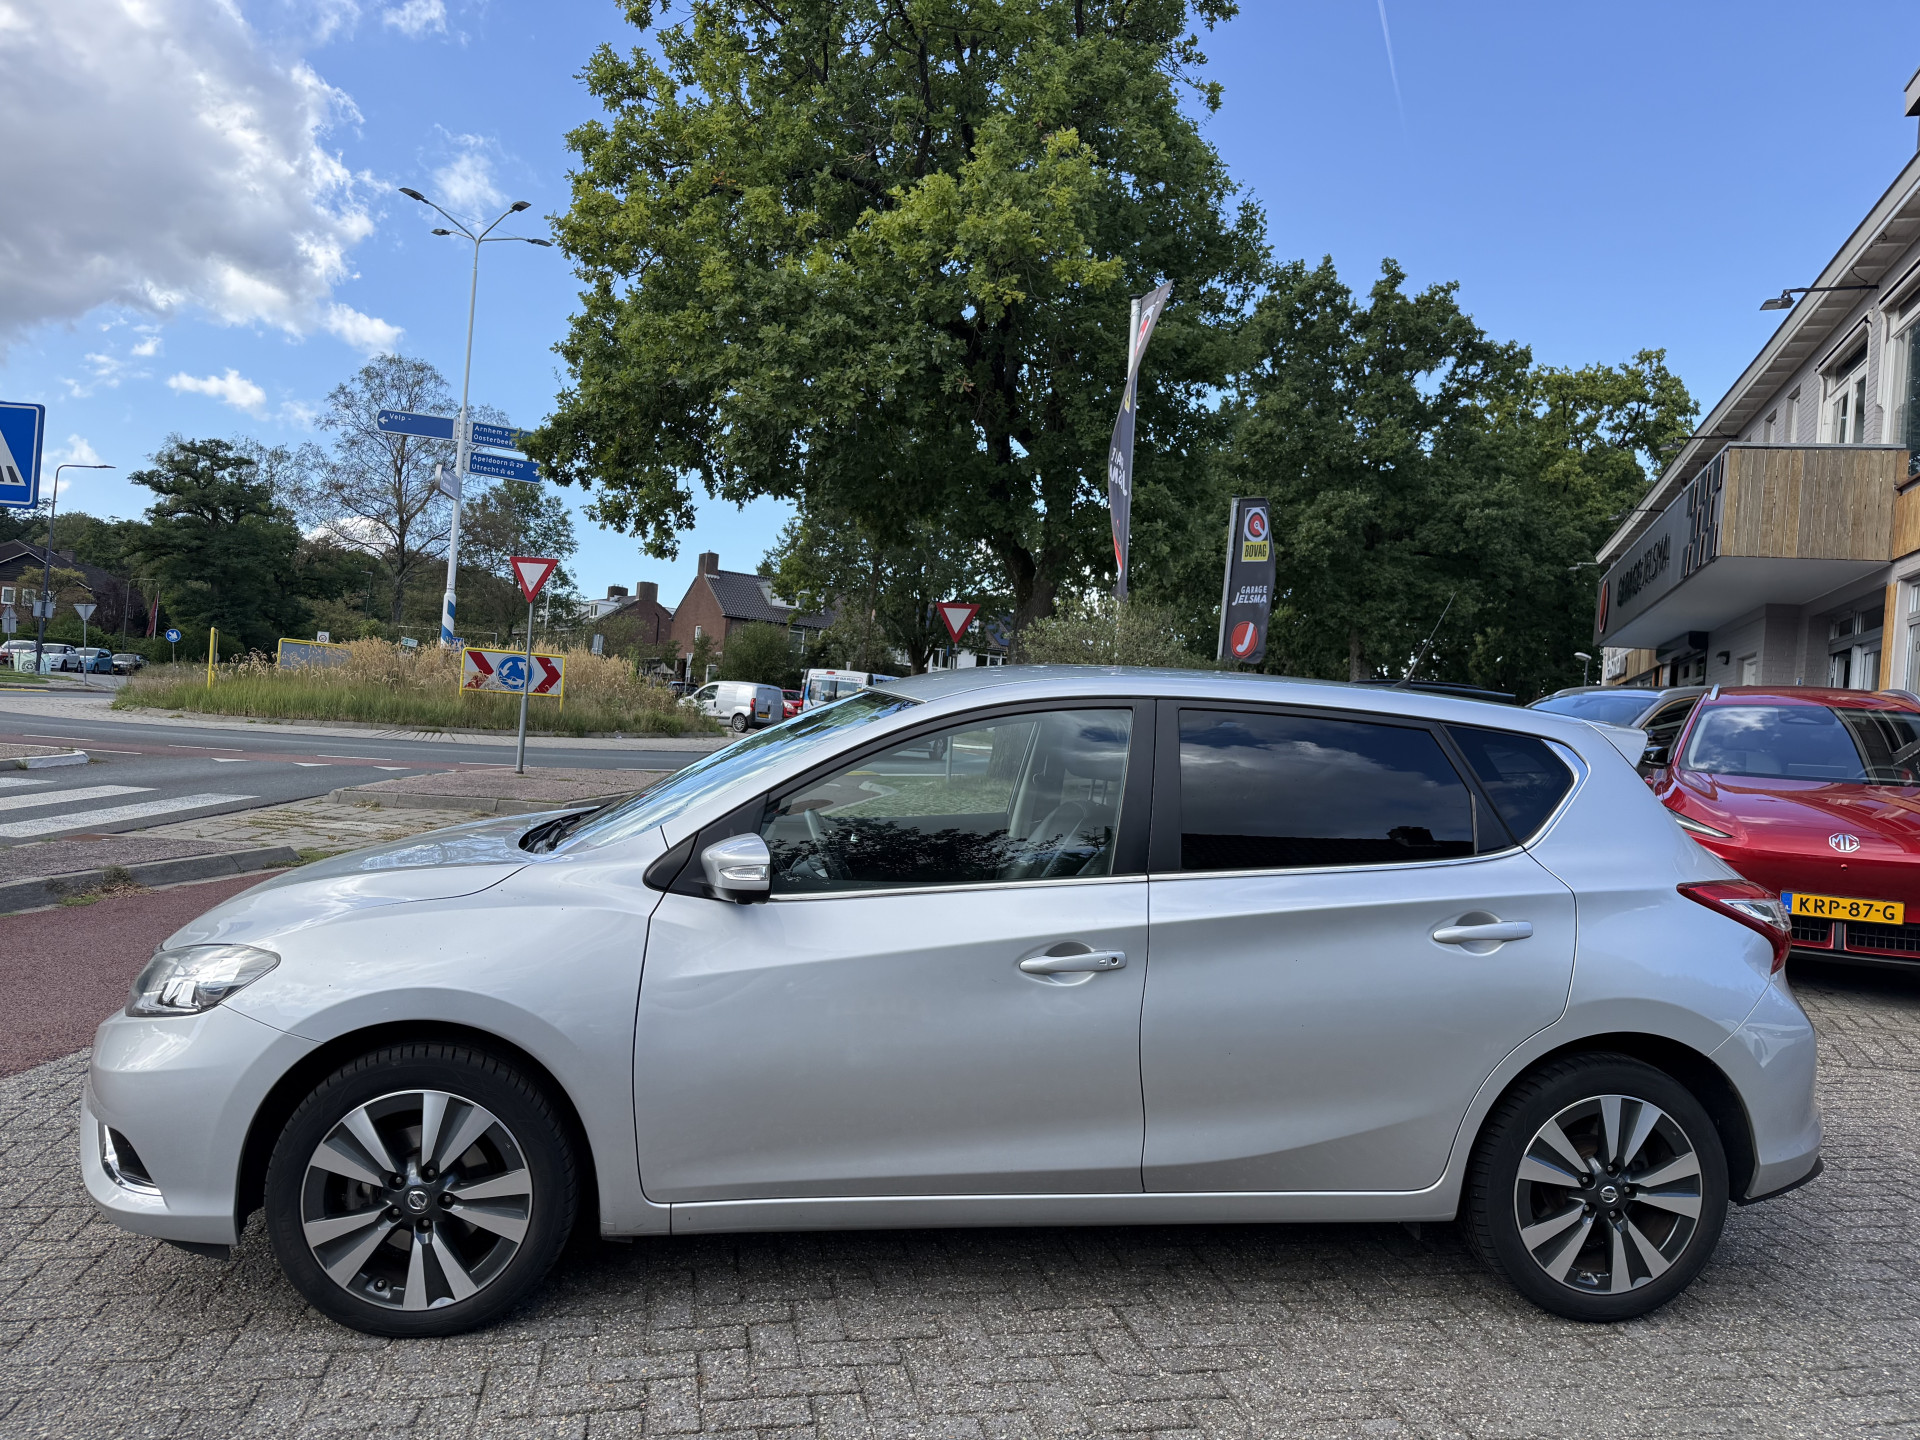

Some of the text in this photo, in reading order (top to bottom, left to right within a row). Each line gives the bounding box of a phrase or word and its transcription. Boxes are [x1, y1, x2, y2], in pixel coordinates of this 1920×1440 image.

[389, 413, 406, 421] Velp
[474, 425, 503, 436] Arnhem
[473, 434, 513, 446] Oosterbeek
[472, 455, 508, 466] Apeldoorn
[471, 463, 499, 473] Utrecht
[1244, 544, 1267, 558] BOVAG
[1240, 585, 1268, 594] GARAGE
[1232, 591, 1268, 606] JELSMA
[1830, 833, 1859, 852] MG
[1799, 897, 1895, 920] KRP-87-G
